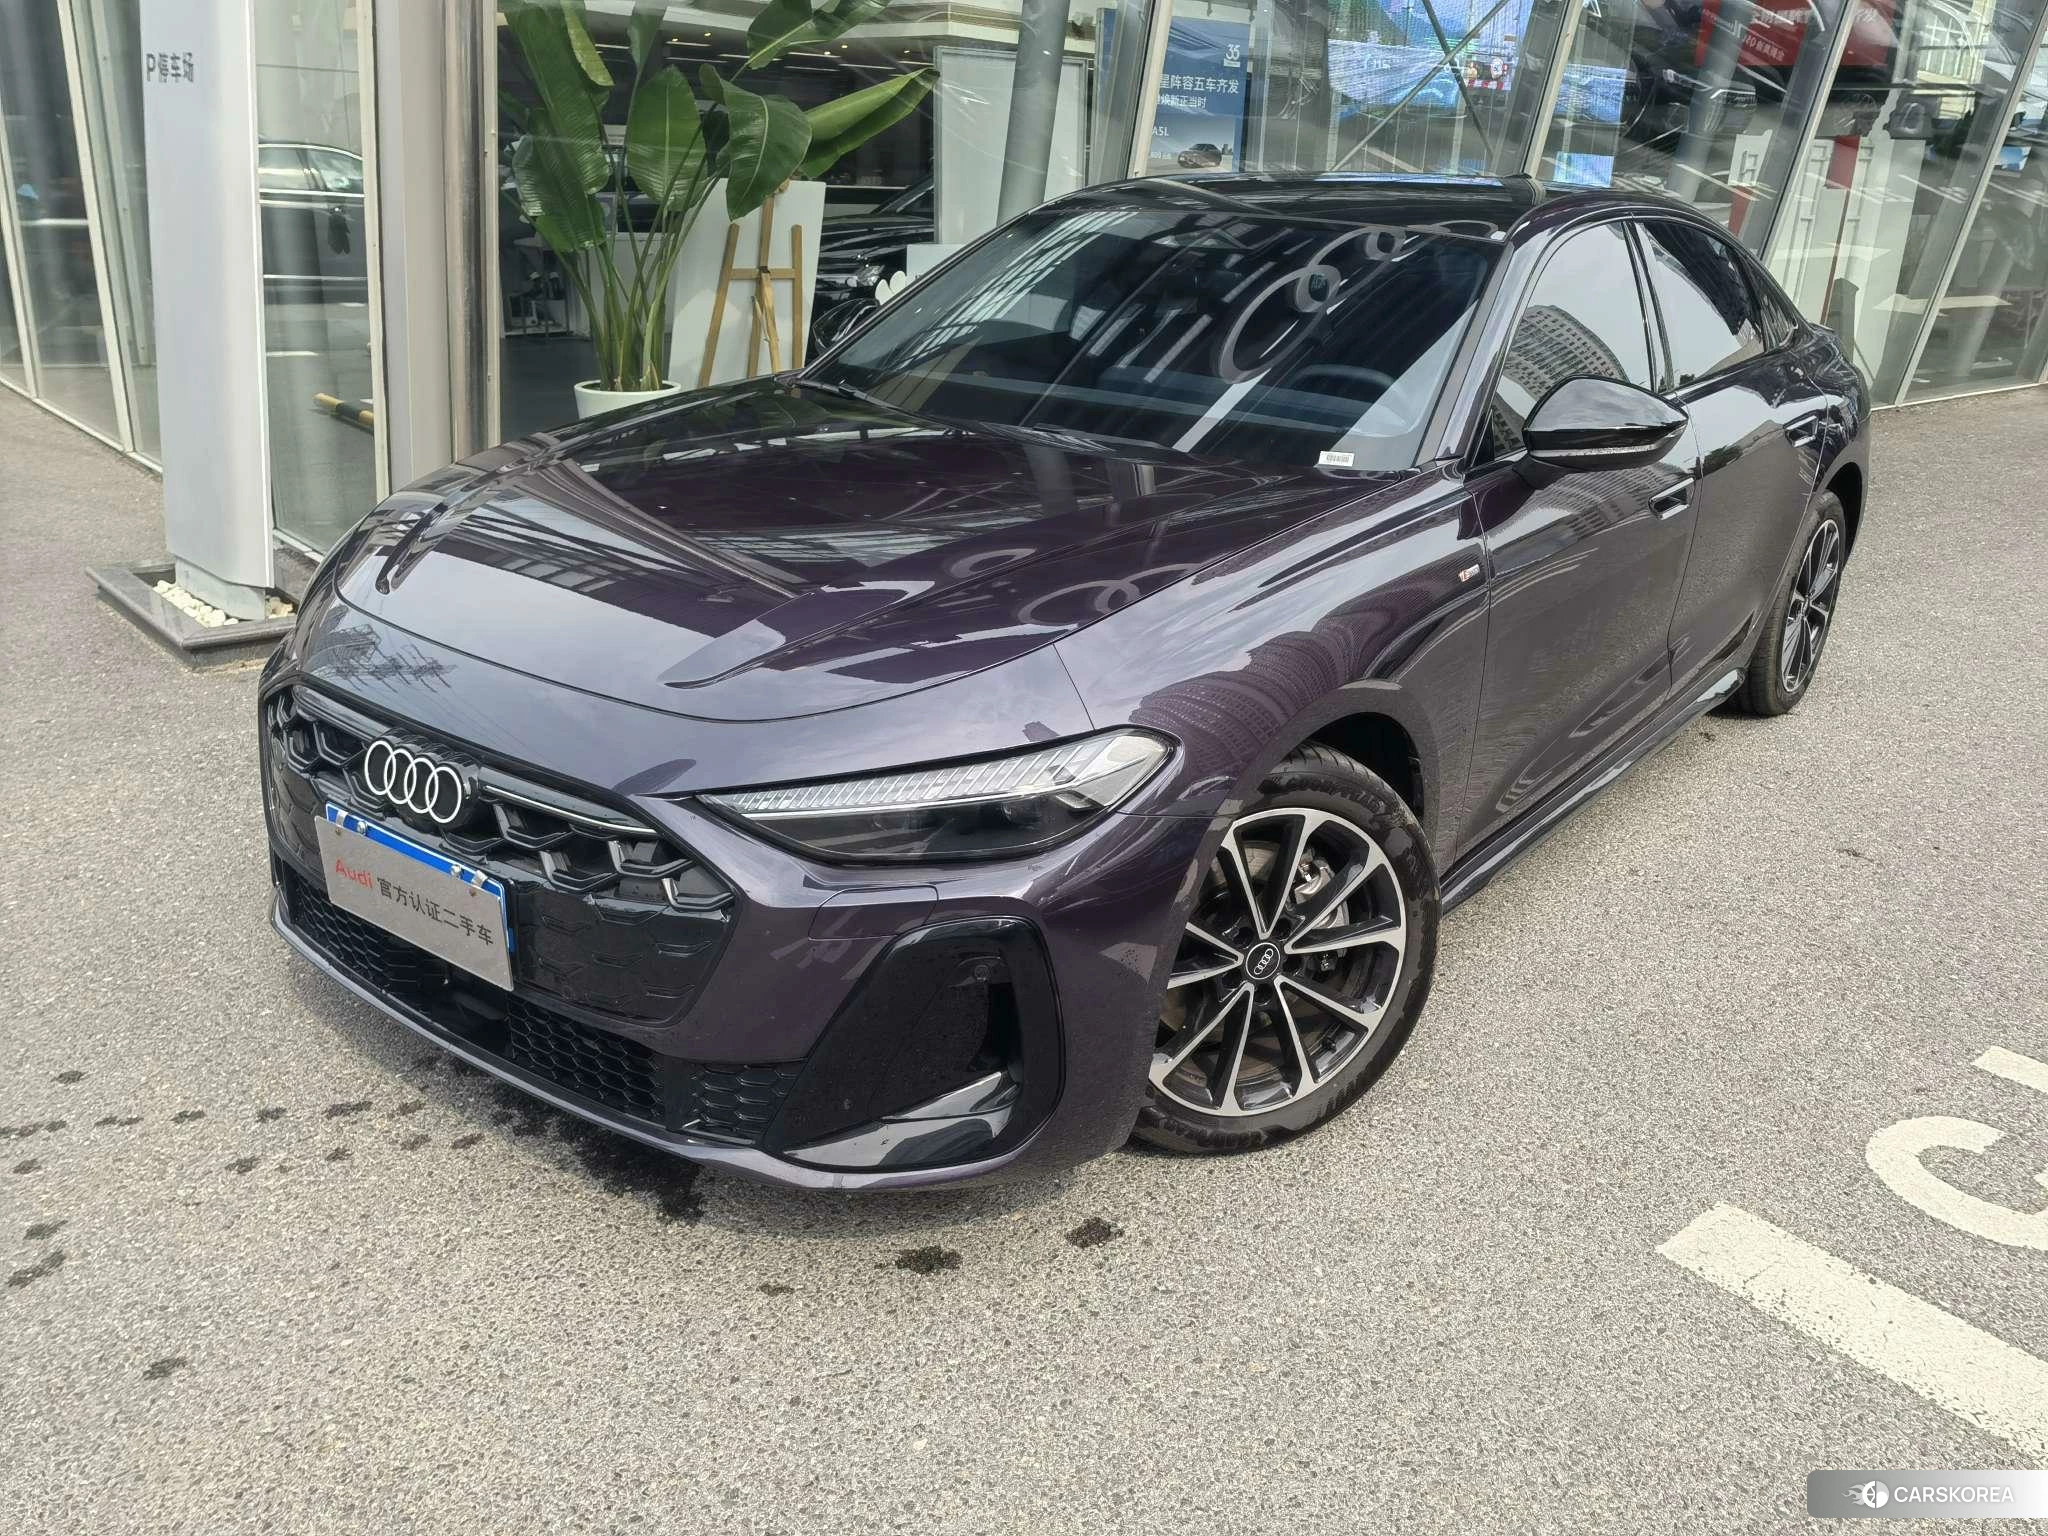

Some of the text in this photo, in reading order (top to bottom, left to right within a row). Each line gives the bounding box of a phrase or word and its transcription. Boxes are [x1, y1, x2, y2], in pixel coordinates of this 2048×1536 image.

[335, 859, 494, 946] Audi 官方认证二手车
